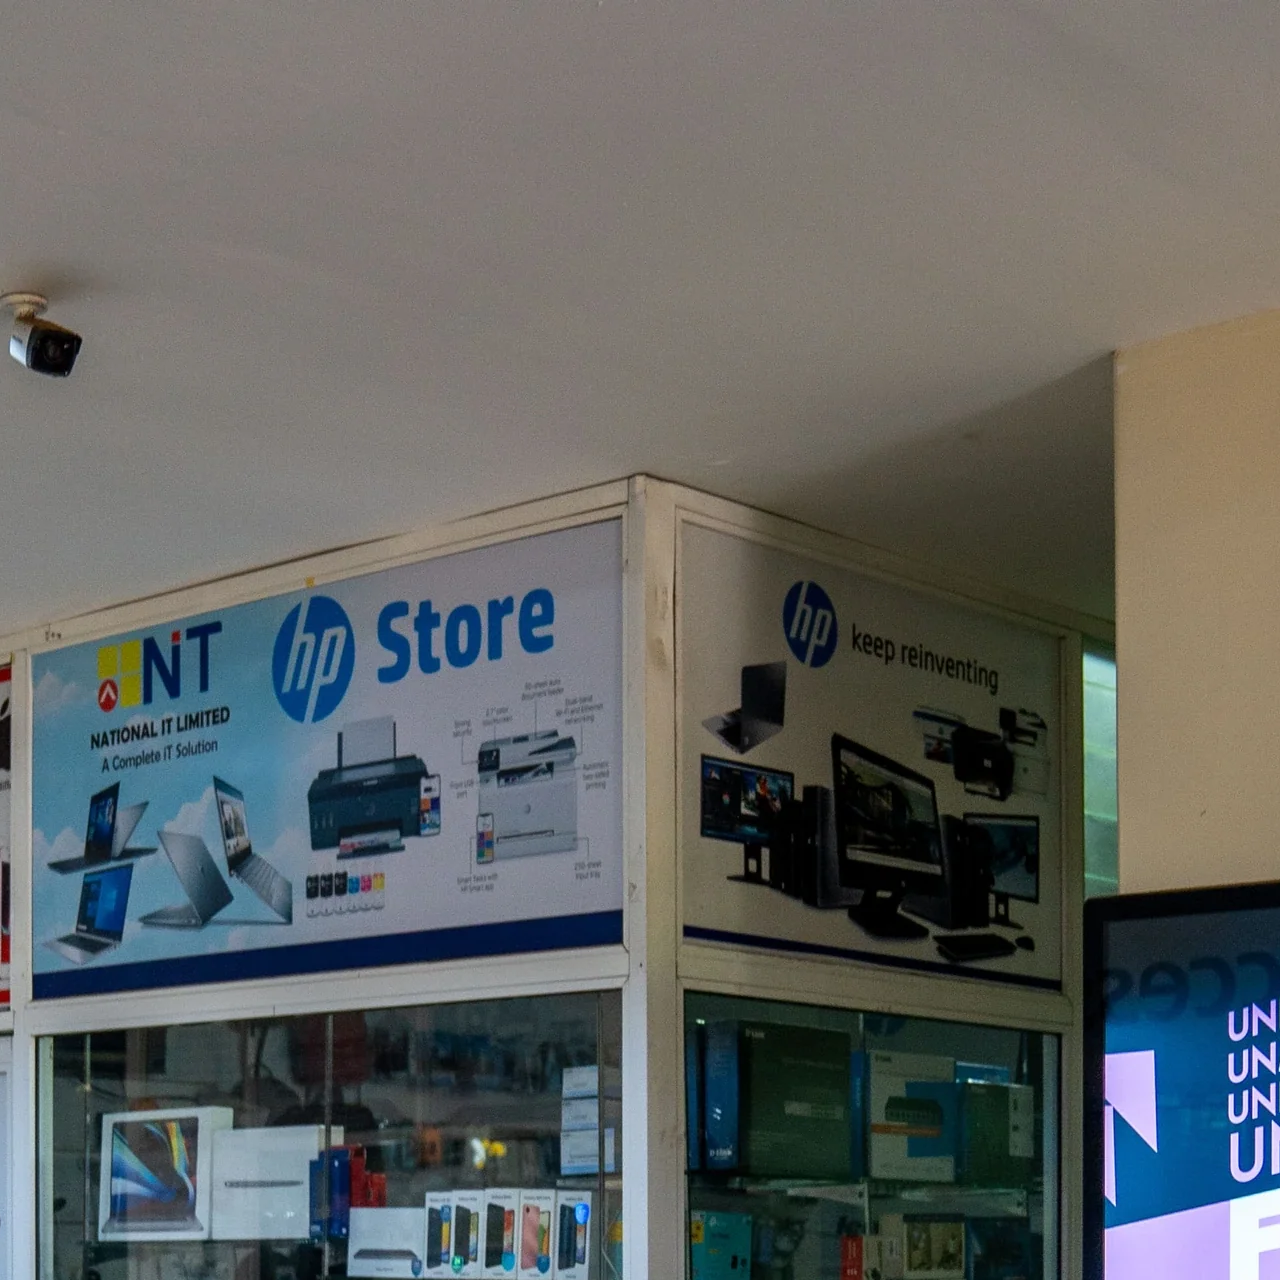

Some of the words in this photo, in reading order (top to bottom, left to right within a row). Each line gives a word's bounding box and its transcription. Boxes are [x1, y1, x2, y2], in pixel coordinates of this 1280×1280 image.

[278, 594, 349, 724] hp
[376, 587, 556, 685] Store
[787, 580, 836, 669] hp
[852, 624, 896, 666] keep
[900, 645, 1000, 696] reinventing
[90, 723, 158, 751] NATIONAL
[161, 719, 174, 738] IT
[176, 706, 231, 733] LIMITED
[101, 758, 110, 773] A
[112, 749, 162, 771] Complete
[176, 738, 219, 759] Solution
